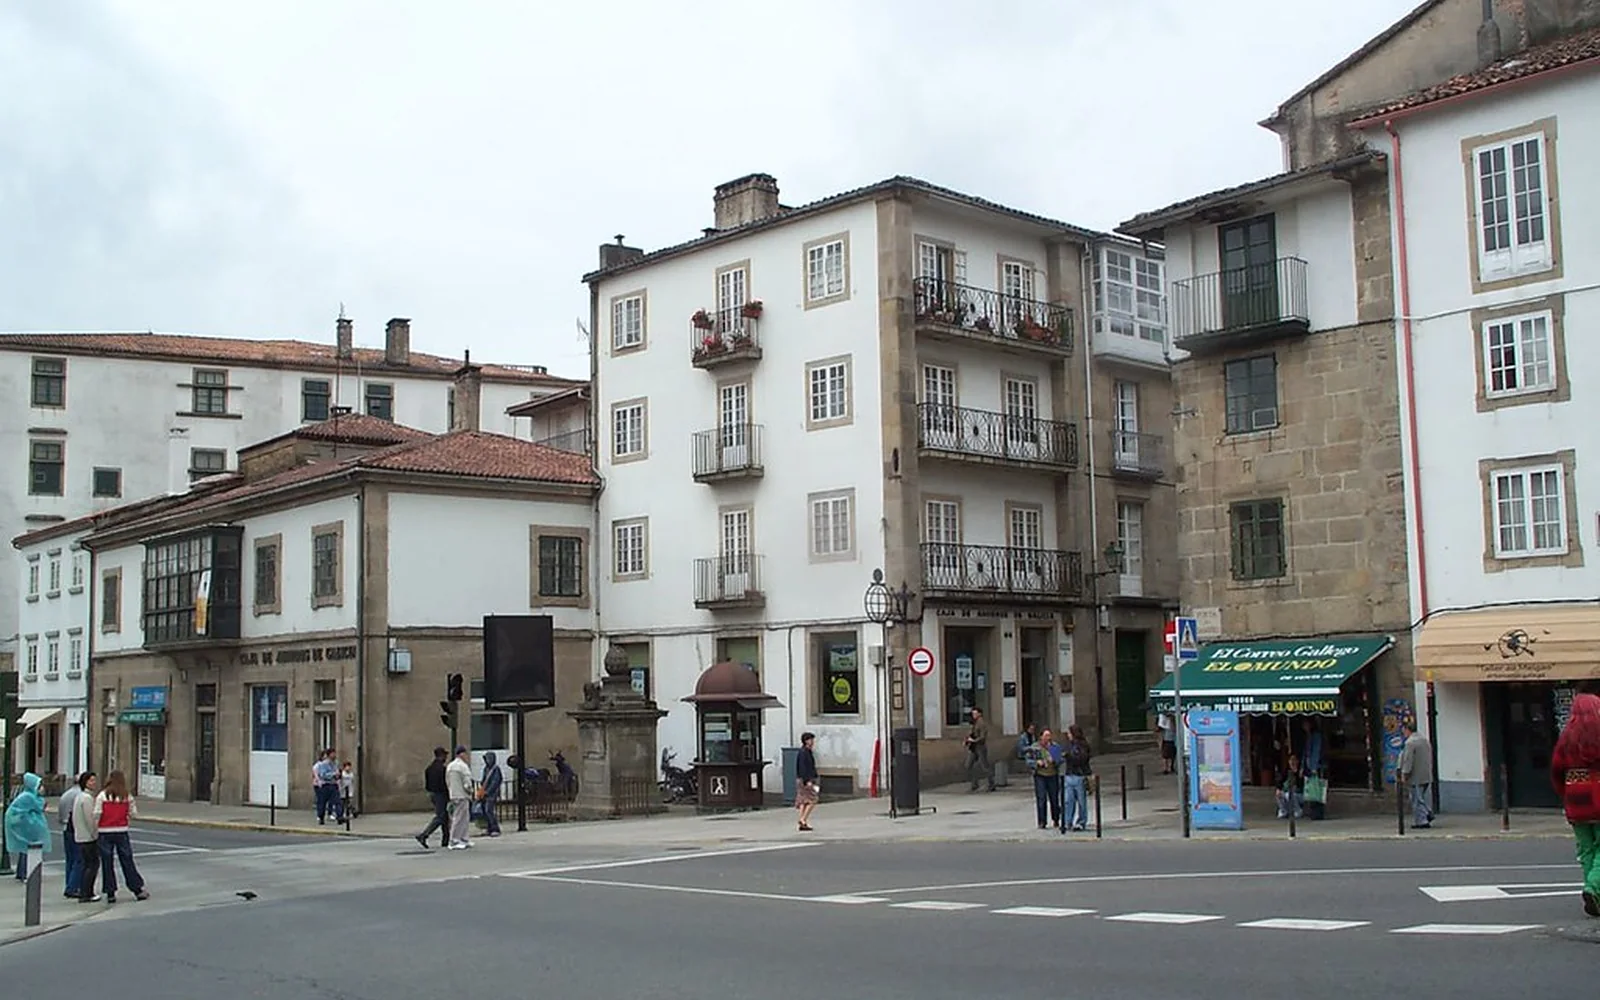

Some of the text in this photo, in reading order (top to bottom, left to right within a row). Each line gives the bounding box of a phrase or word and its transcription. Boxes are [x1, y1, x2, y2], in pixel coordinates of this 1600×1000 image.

[1210, 644, 1359, 659] El Correo Gallego
